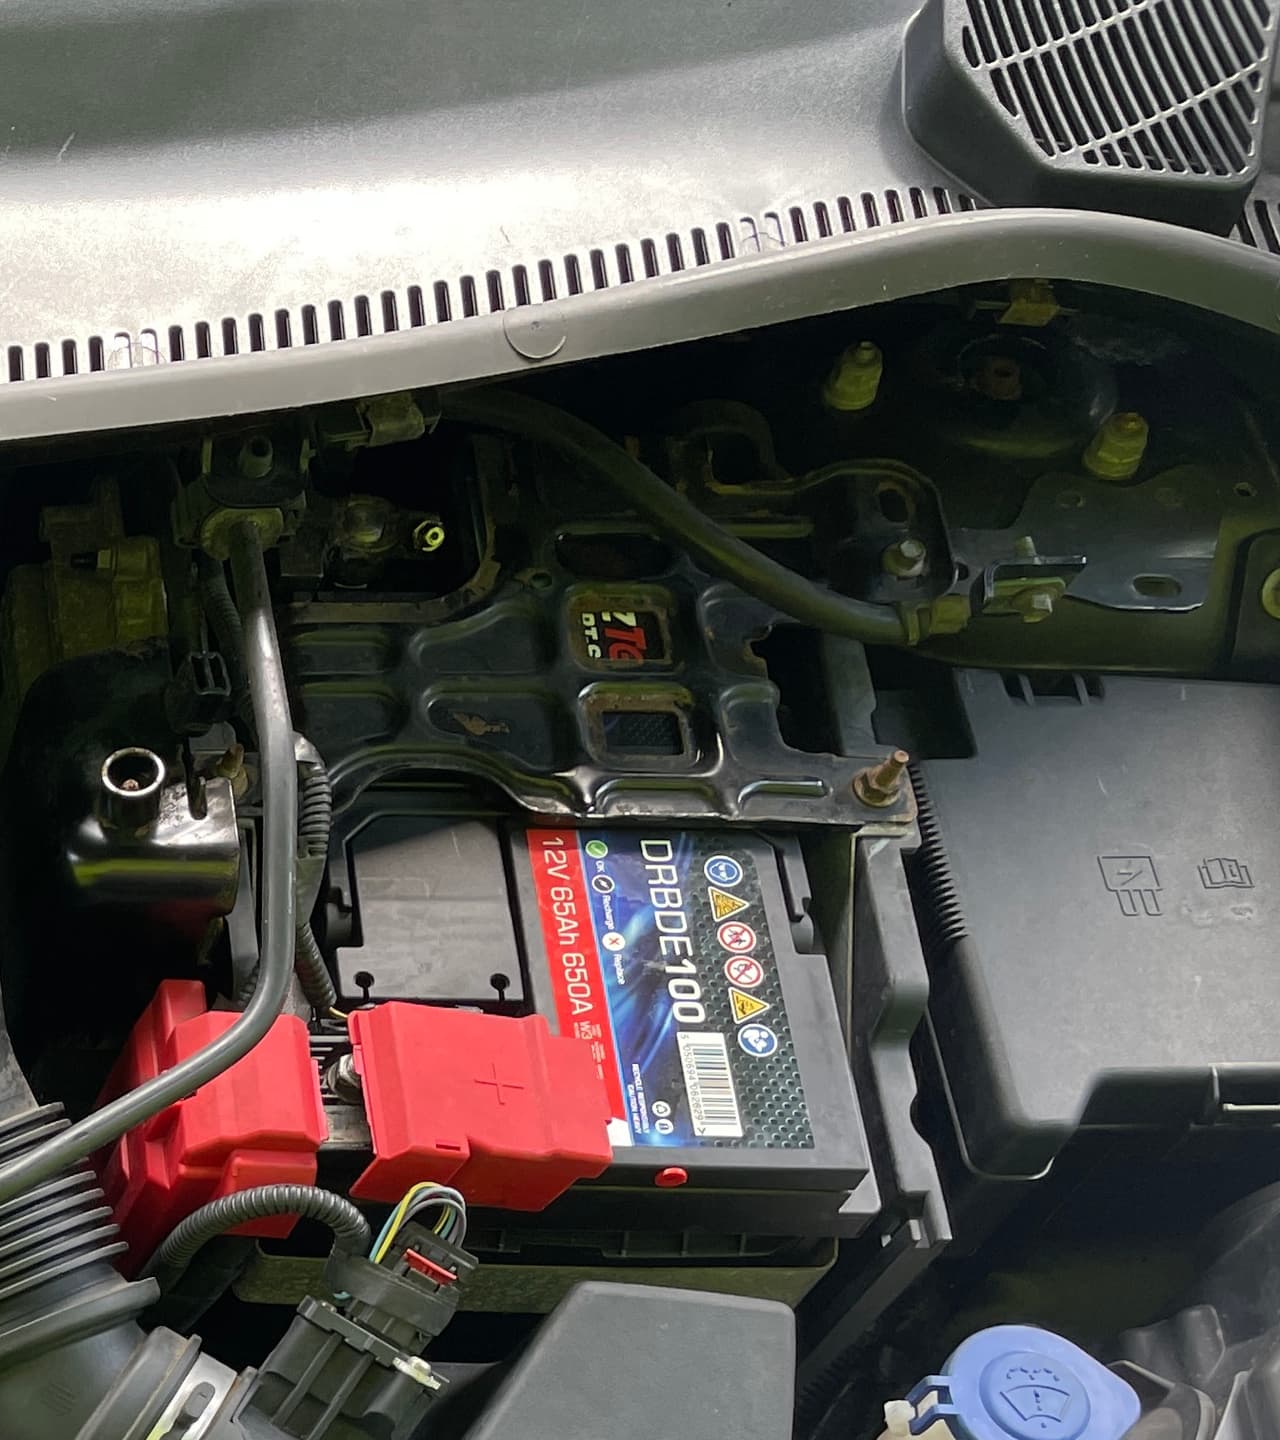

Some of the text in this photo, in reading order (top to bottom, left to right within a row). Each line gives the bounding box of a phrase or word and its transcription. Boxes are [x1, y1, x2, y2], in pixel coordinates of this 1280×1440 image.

[542, 837, 594, 1016] 12V 65Ah 650A
[602, 894, 615, 930] Recharge
[613, 953, 626, 985] Replace
[640, 839, 706, 1024] DRBDE100
